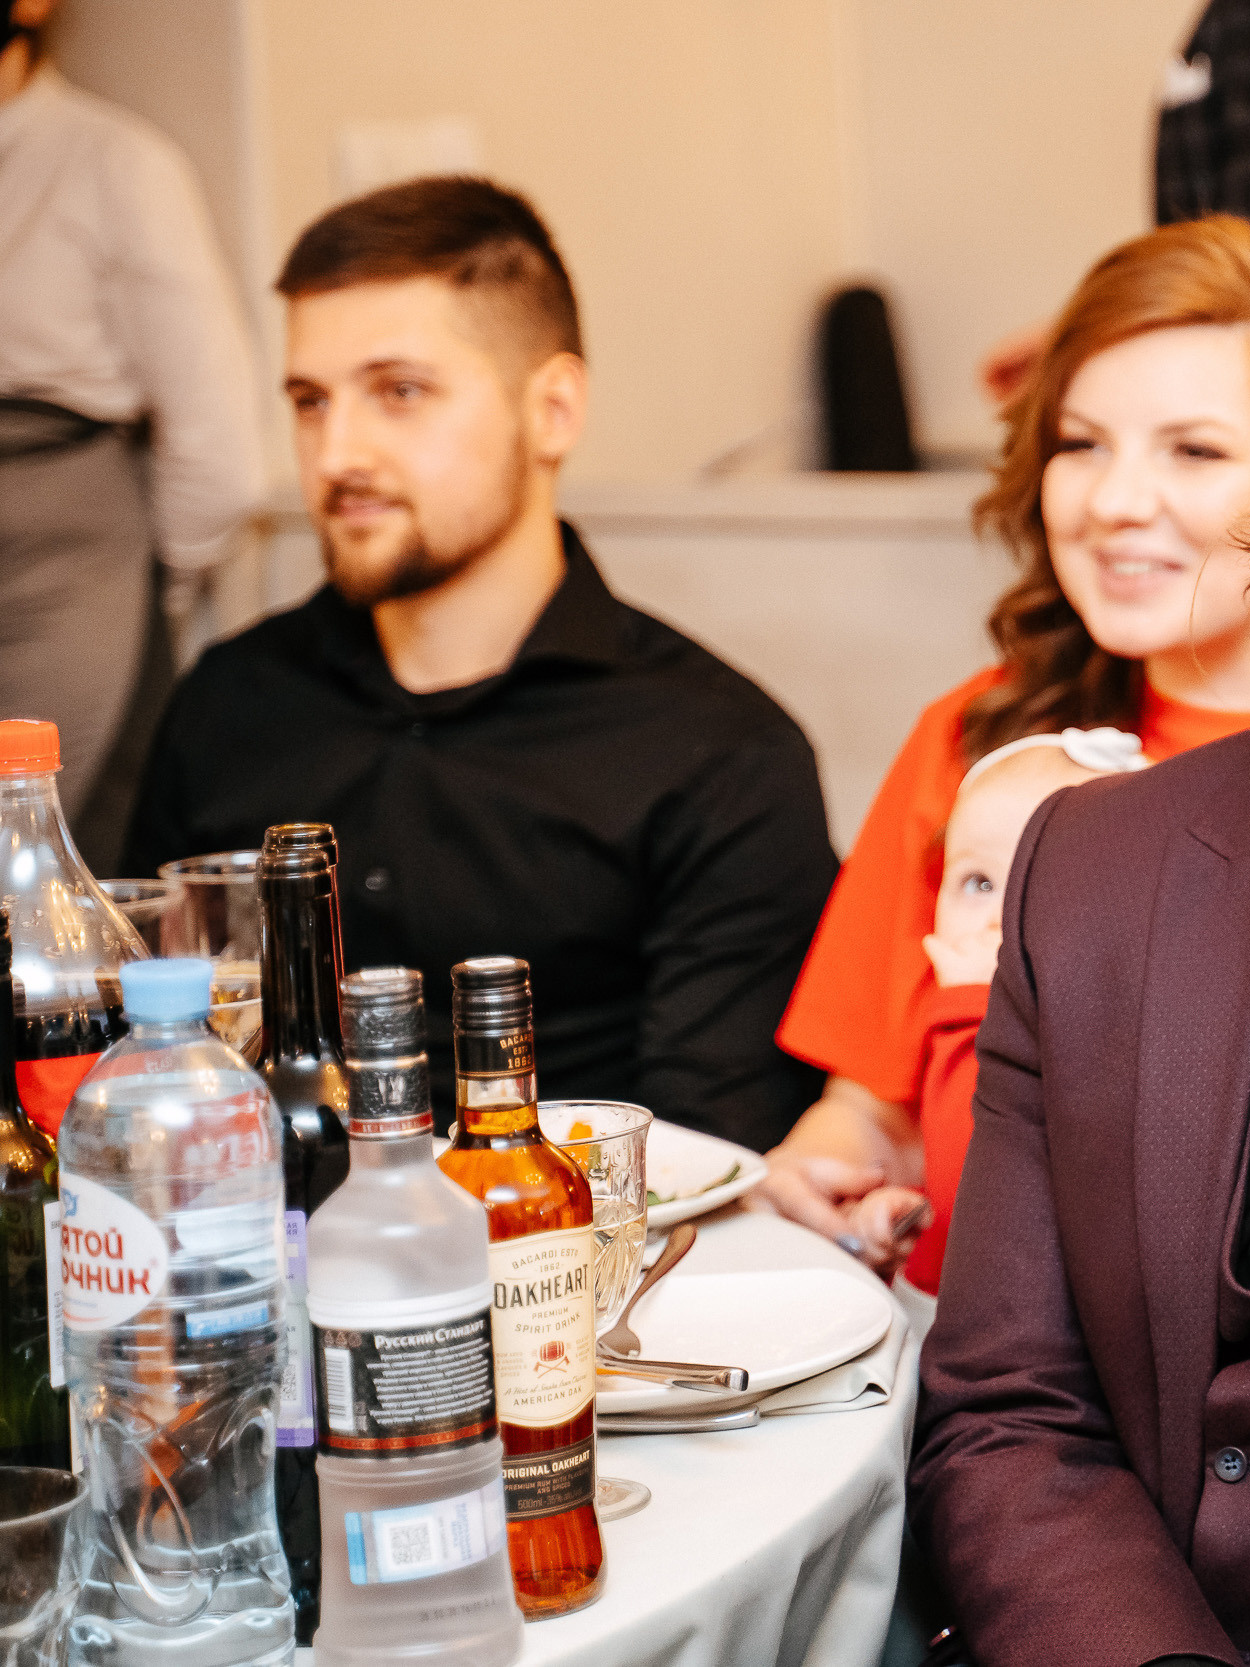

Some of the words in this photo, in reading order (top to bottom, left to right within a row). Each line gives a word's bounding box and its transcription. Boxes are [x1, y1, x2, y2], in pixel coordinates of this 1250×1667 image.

[507, 1054, 531, 1069] 1862
[511, 1249, 558, 1270] BACARDI
[540, 1261, 561, 1273] 1862
[493, 1263, 589, 1310] OAKHEART
[514, 1323, 551, 1334] SPIRIT
[554, 1312, 581, 1331] DRINK
[532, 1306, 569, 1320] PREMIUM
[513, 1391, 565, 1406] AMERICAN
[568, 1385, 582, 1397] OAK
[502, 1464, 550, 1479] ORIGINAL
[552, 1450, 590, 1472] OAKHEART
[504, 1481, 536, 1491] PREMIUM
